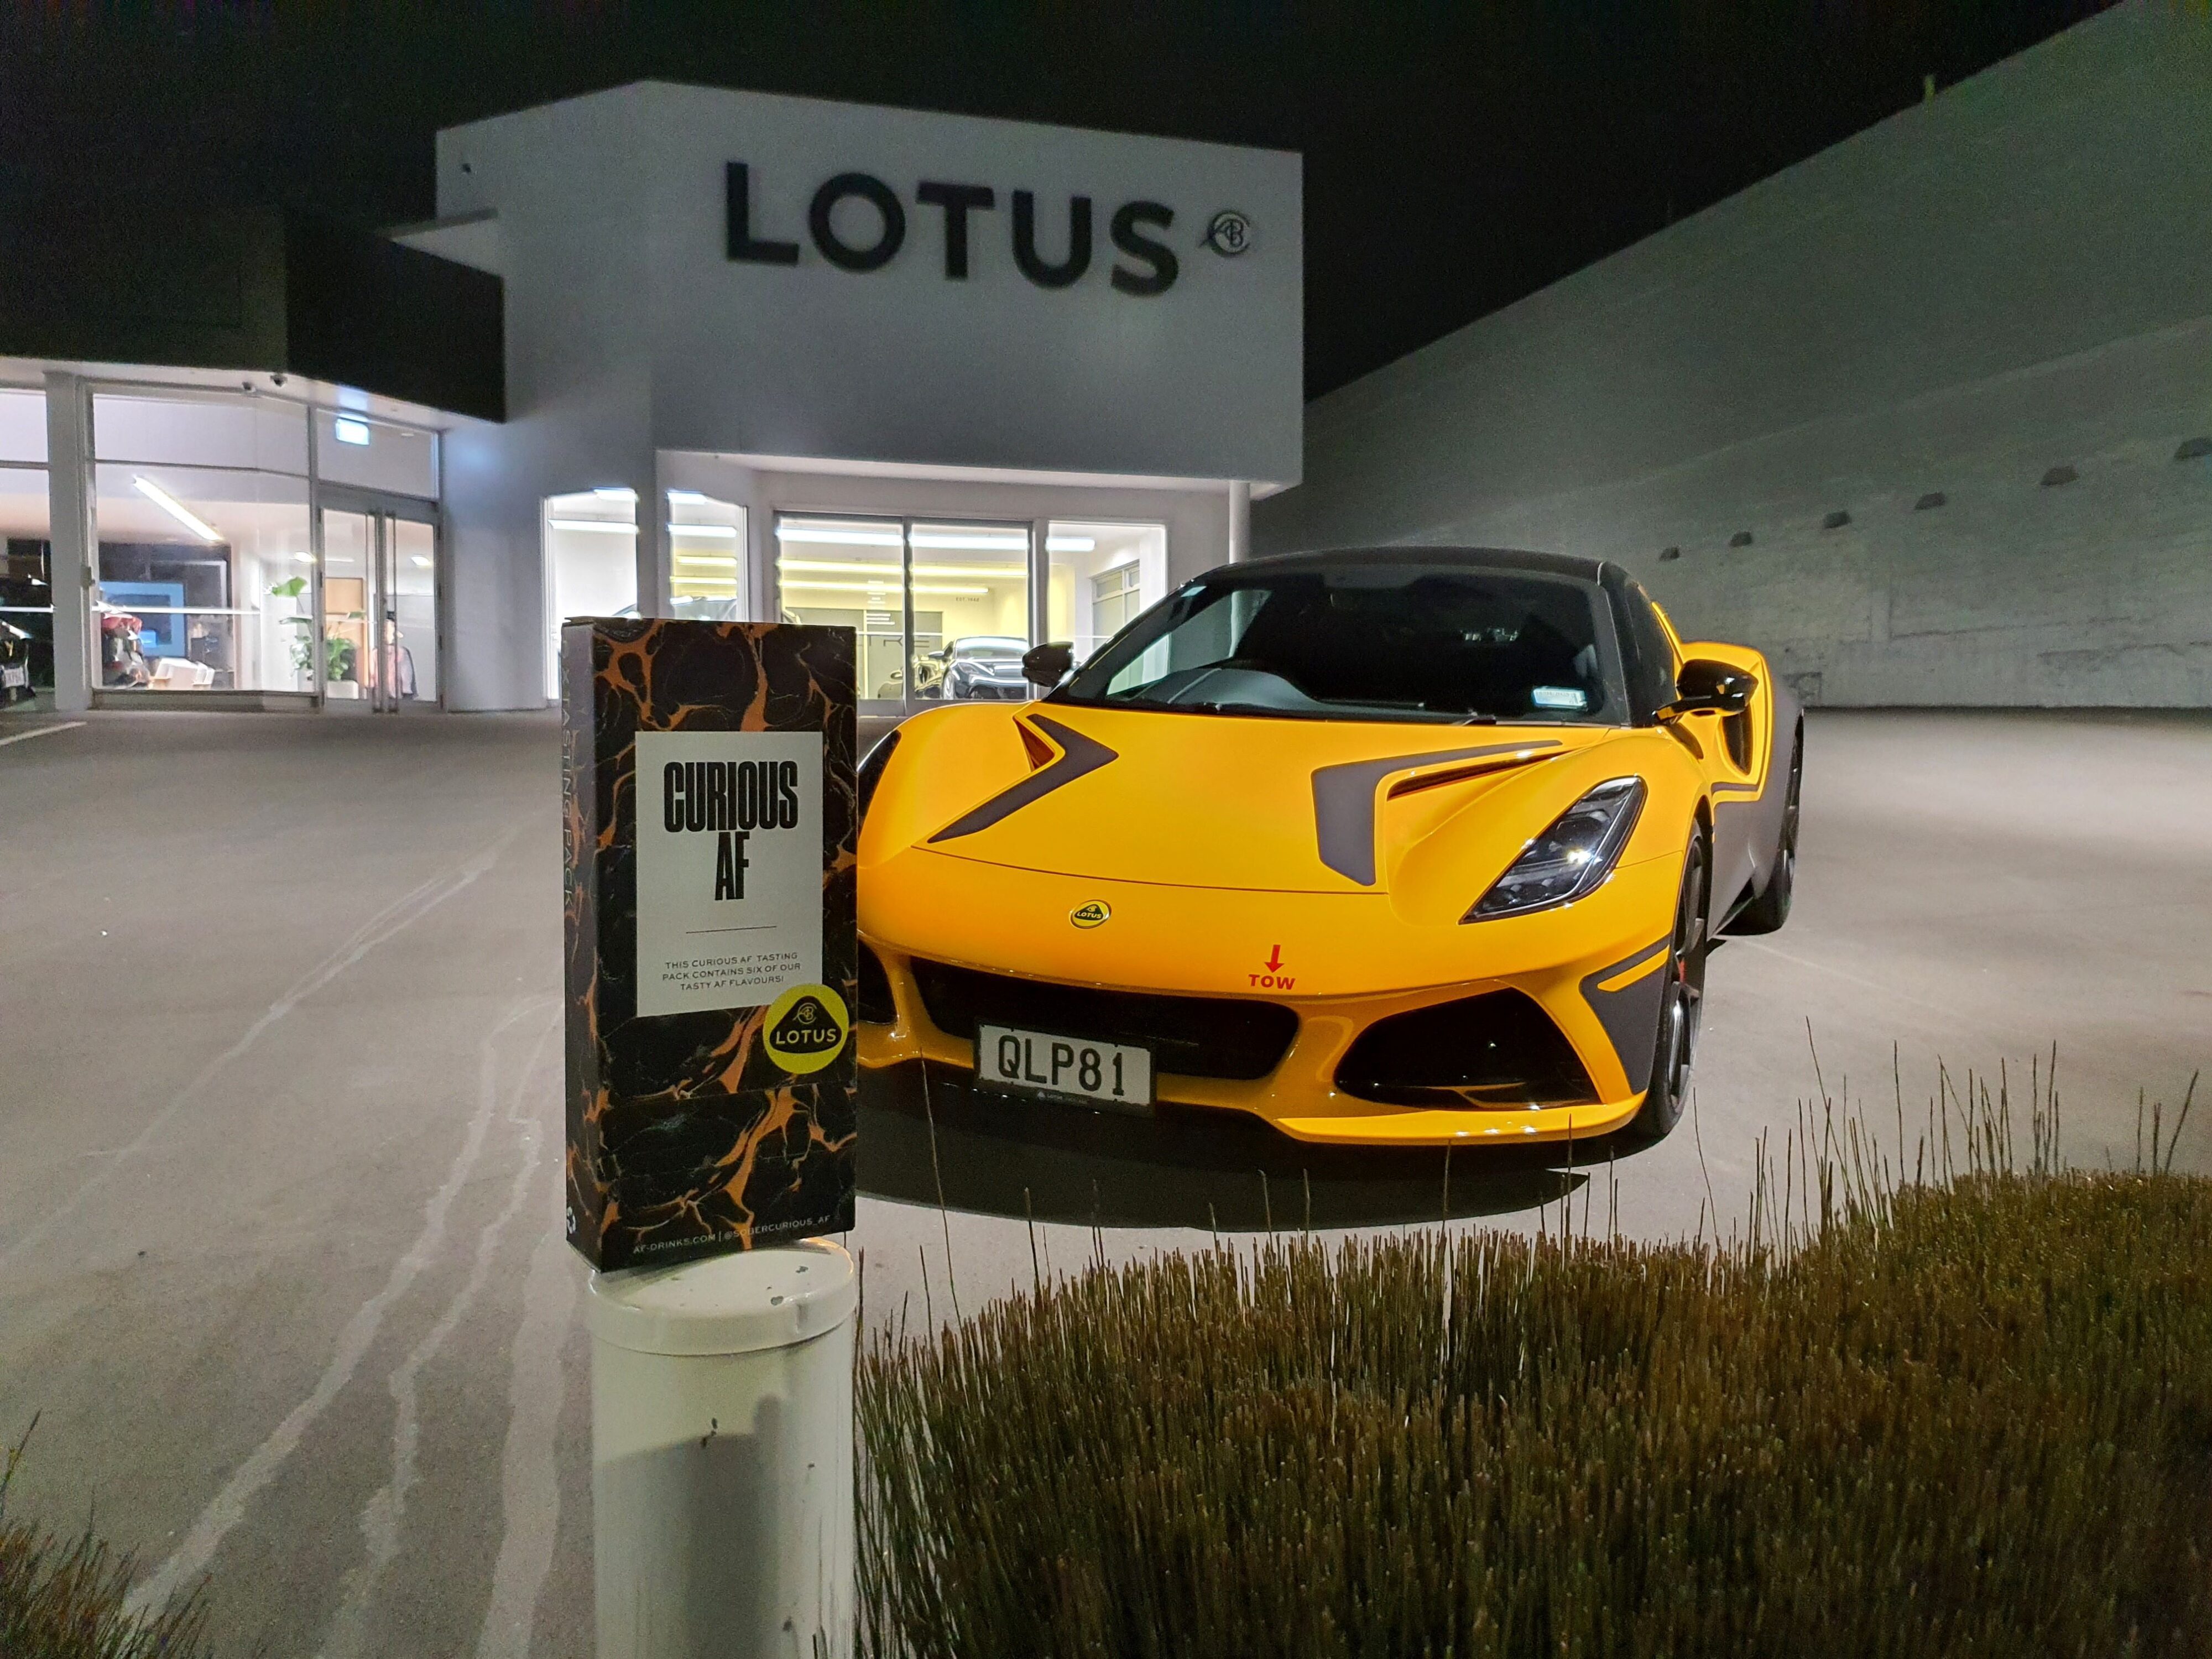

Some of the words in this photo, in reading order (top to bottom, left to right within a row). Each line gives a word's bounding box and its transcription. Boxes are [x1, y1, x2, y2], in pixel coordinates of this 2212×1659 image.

[726, 162, 1179, 297] LOTUS
[562, 690, 571, 818] TASTING
[664, 761, 799, 832] CURIOUS
[564, 828, 573, 907] PACK
[714, 831, 750, 901] AF
[662, 972, 689, 981] PACK
[692, 968, 744, 979] CONTAINS
[746, 966, 763, 974] SIX
[764, 964, 778, 973] OF
[780, 963, 801, 972] OUR
[665, 961, 689, 969] THIS
[692, 957, 738, 968] CURIOUS
[740, 955, 753, 963] AF
[757, 952, 798, 962] TASTING
[1248, 973, 1296, 990] TOW
[680, 982, 711, 991] TASTY
[713, 980, 727, 988] AF
[729, 975, 784, 987] FLAVOURS!
[775, 1028, 837, 1045] LOTUS
[998, 1034, 1125, 1097] QLP81
[633, 1233, 716, 1254] AF-DRINKS.COM
